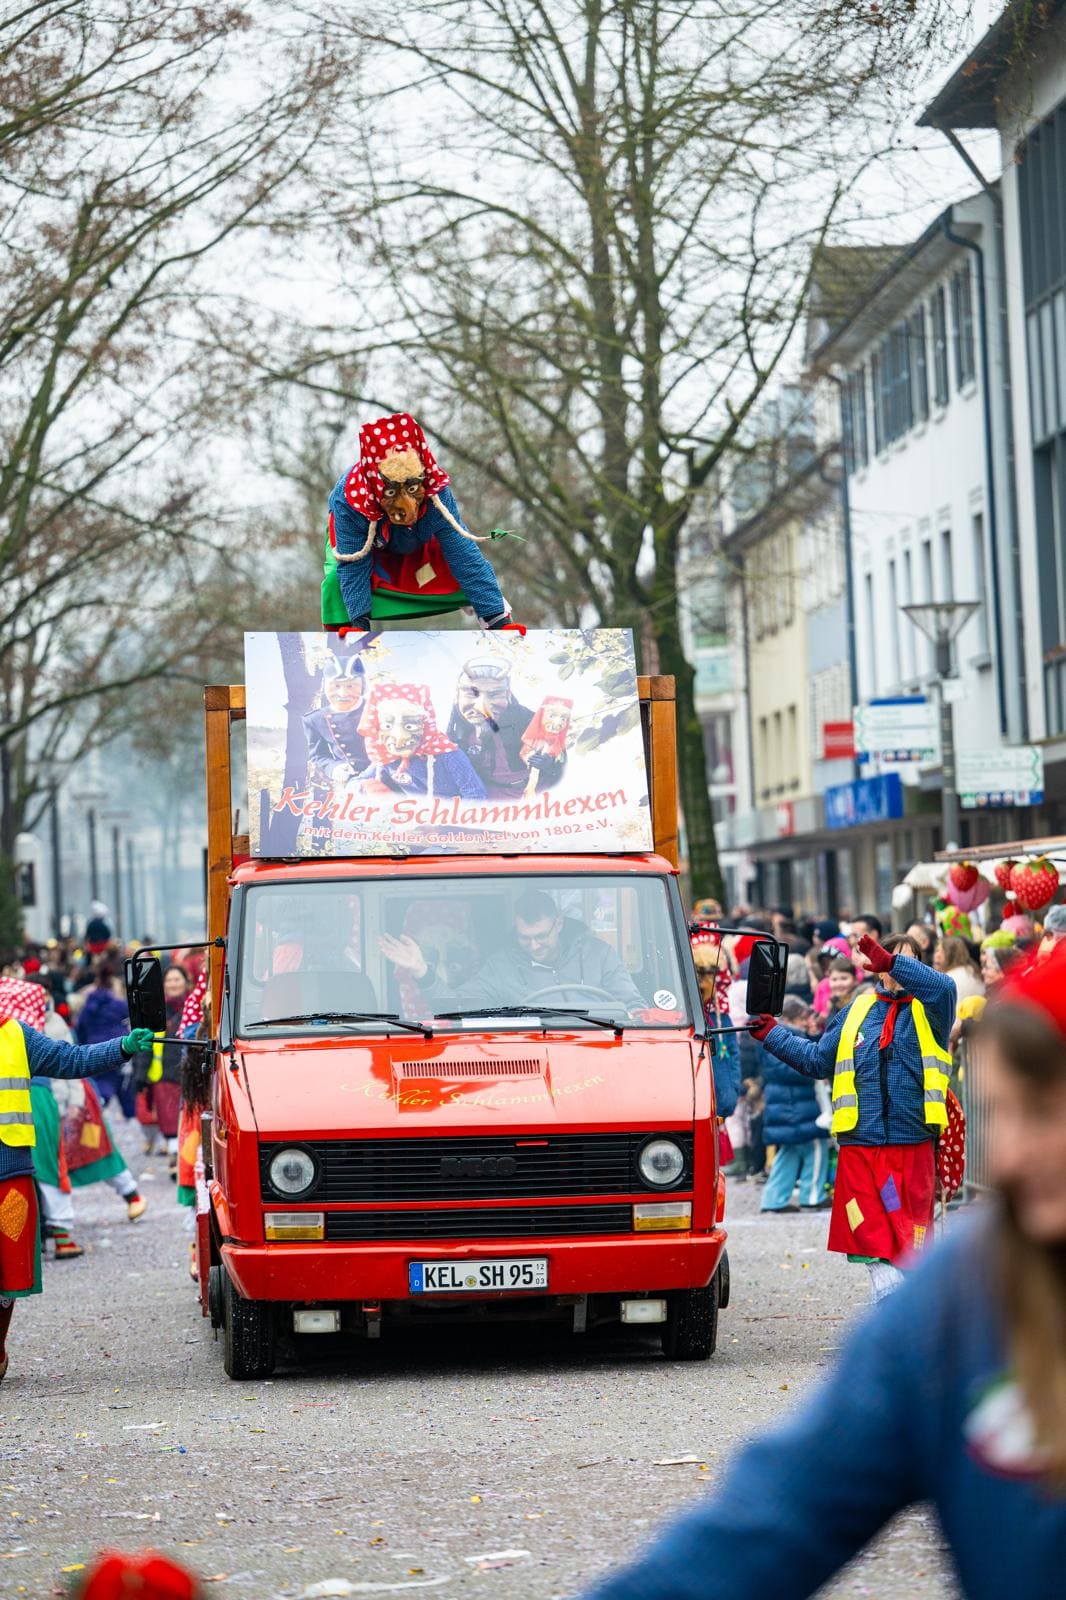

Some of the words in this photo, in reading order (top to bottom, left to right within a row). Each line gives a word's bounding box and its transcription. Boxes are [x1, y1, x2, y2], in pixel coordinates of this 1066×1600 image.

[274, 787, 380, 822] Kehler
[390, 788, 628, 825] Schlammhexen
[303, 826, 331, 838] mit
[333, 828, 367, 841] dem
[372, 831, 423, 843] Kehler
[511, 830, 540, 840] von
[545, 823, 582, 836] 1802
[585, 818, 613, 831] e.V.
[414, 1279, 420, 1287] D
[424, 1266, 464, 1288] KEL
[479, 1264, 505, 1287] SH
[509, 1263, 534, 1286] 95
